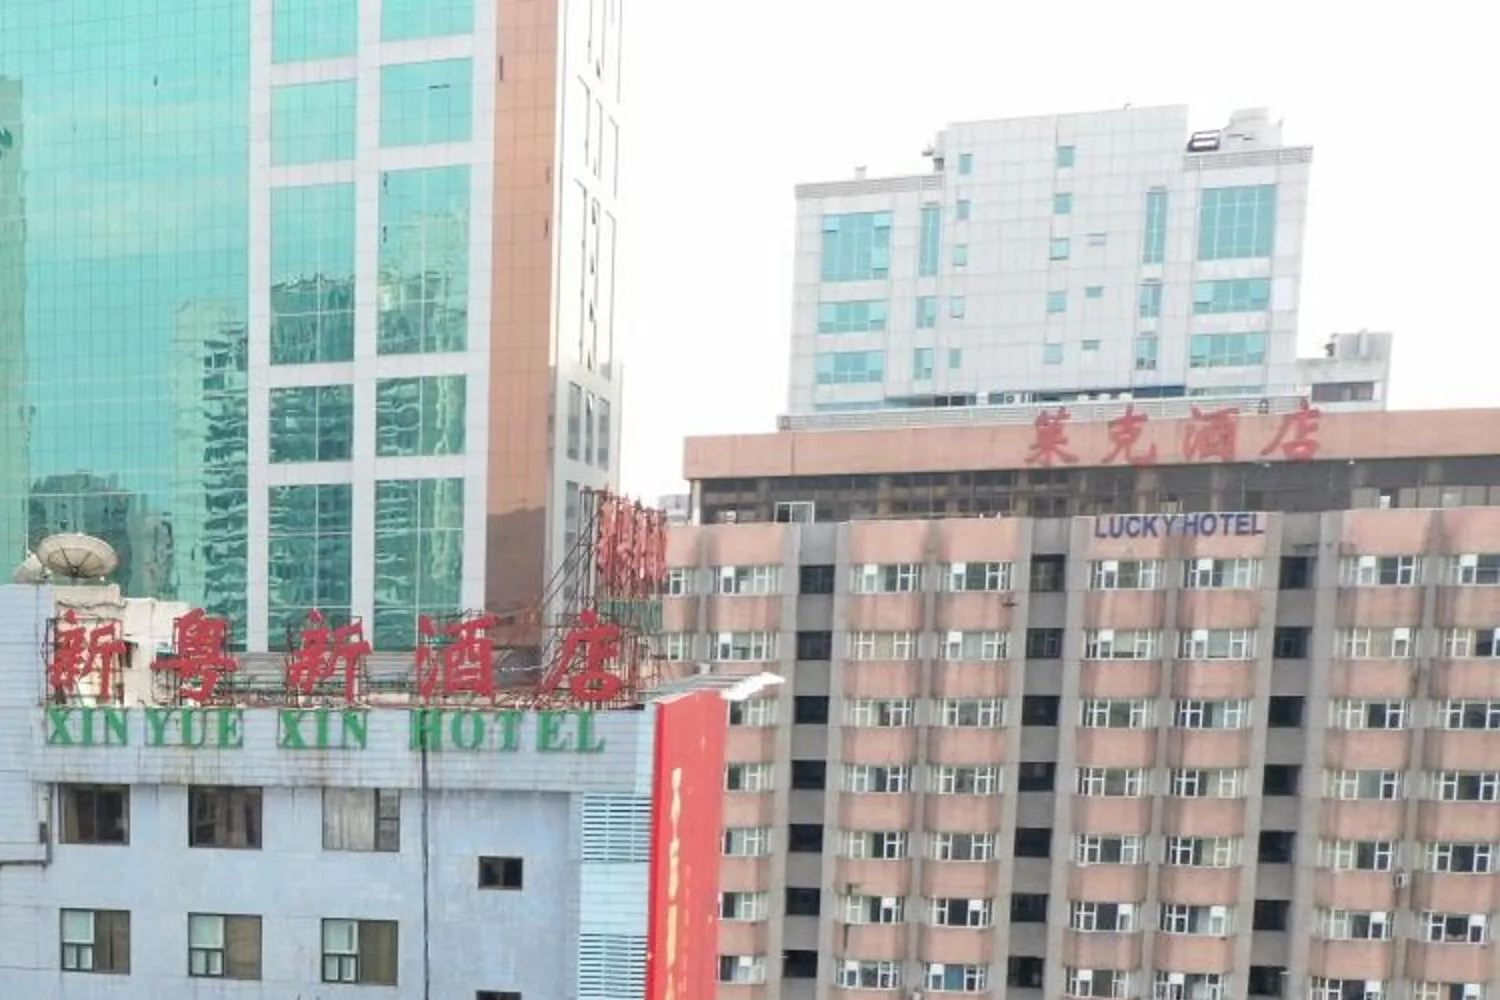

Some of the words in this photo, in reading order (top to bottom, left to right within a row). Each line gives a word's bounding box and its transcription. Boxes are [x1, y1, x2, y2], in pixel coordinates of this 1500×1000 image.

[1024, 399, 1321, 466] 莱克酒店
[1094, 515, 1176, 538] LUCKY
[1182, 513, 1265, 537] HOTEL
[50, 608, 621, 702] 新粤新酒店
[48, 708, 128, 746] XIN
[145, 708, 243, 748] YUE
[280, 708, 367, 750] XIN
[409, 709, 606, 752] HOTEL
